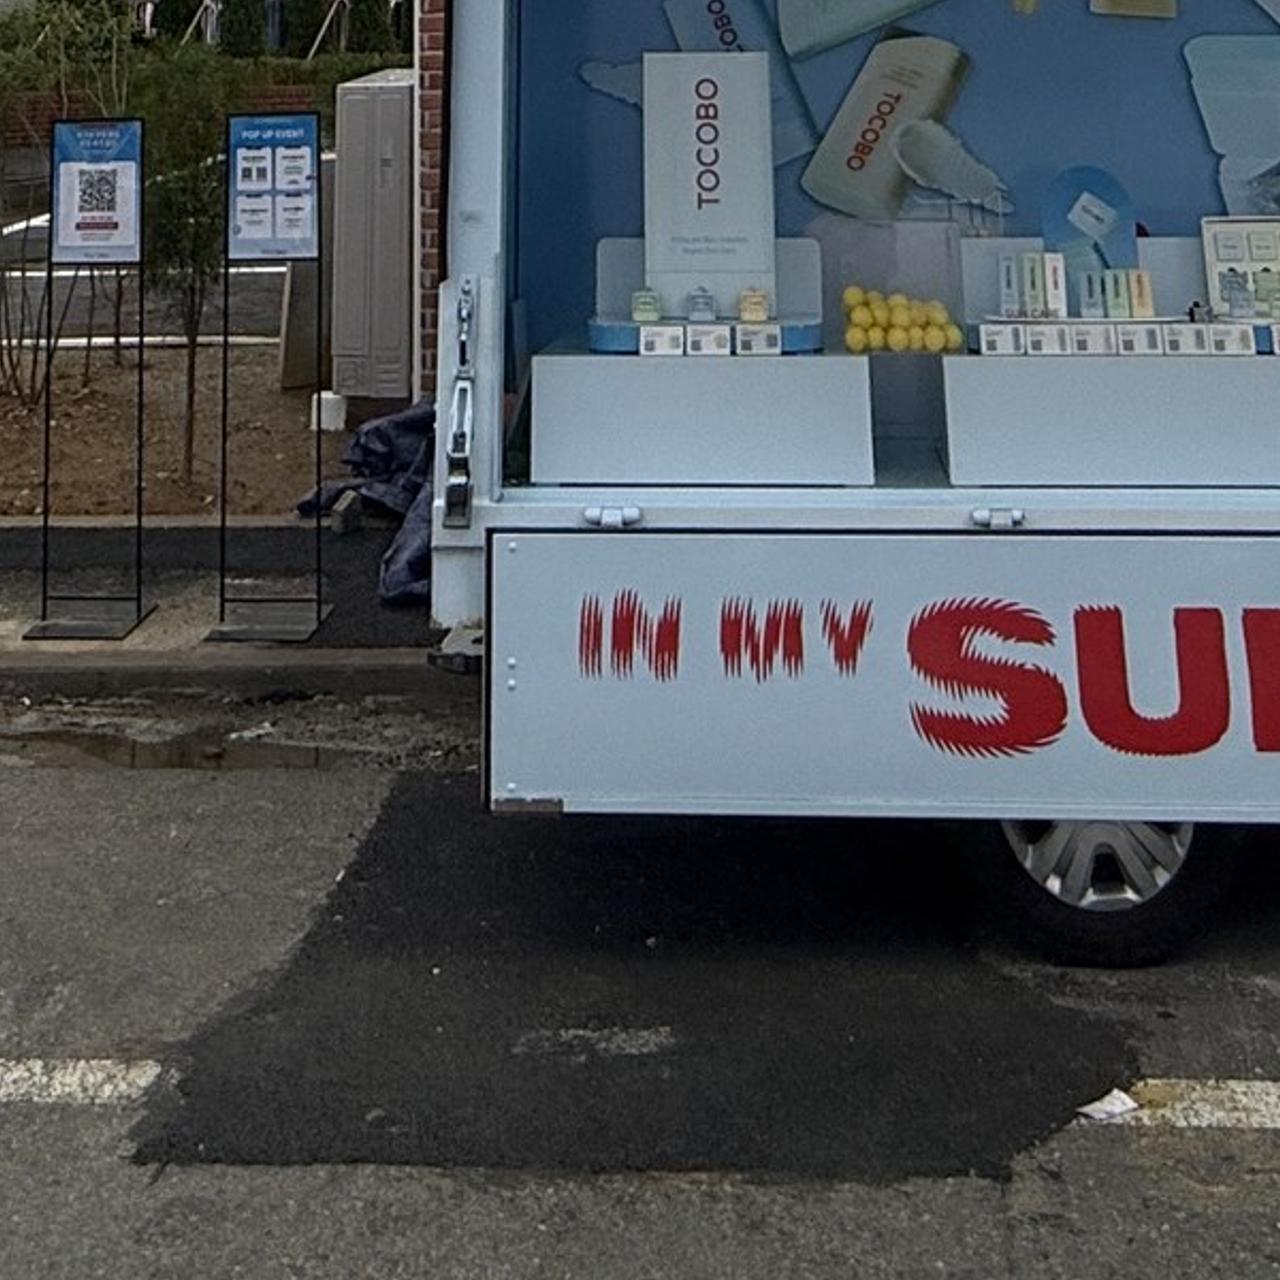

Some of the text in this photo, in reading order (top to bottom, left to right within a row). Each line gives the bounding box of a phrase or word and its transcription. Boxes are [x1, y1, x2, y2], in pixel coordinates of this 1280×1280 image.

[694, 77, 720, 210] TOCOBO
[846, 91, 903, 172] TOCOBO
[578, 588, 682, 683] IN
[719, 594, 874, 685] MY
